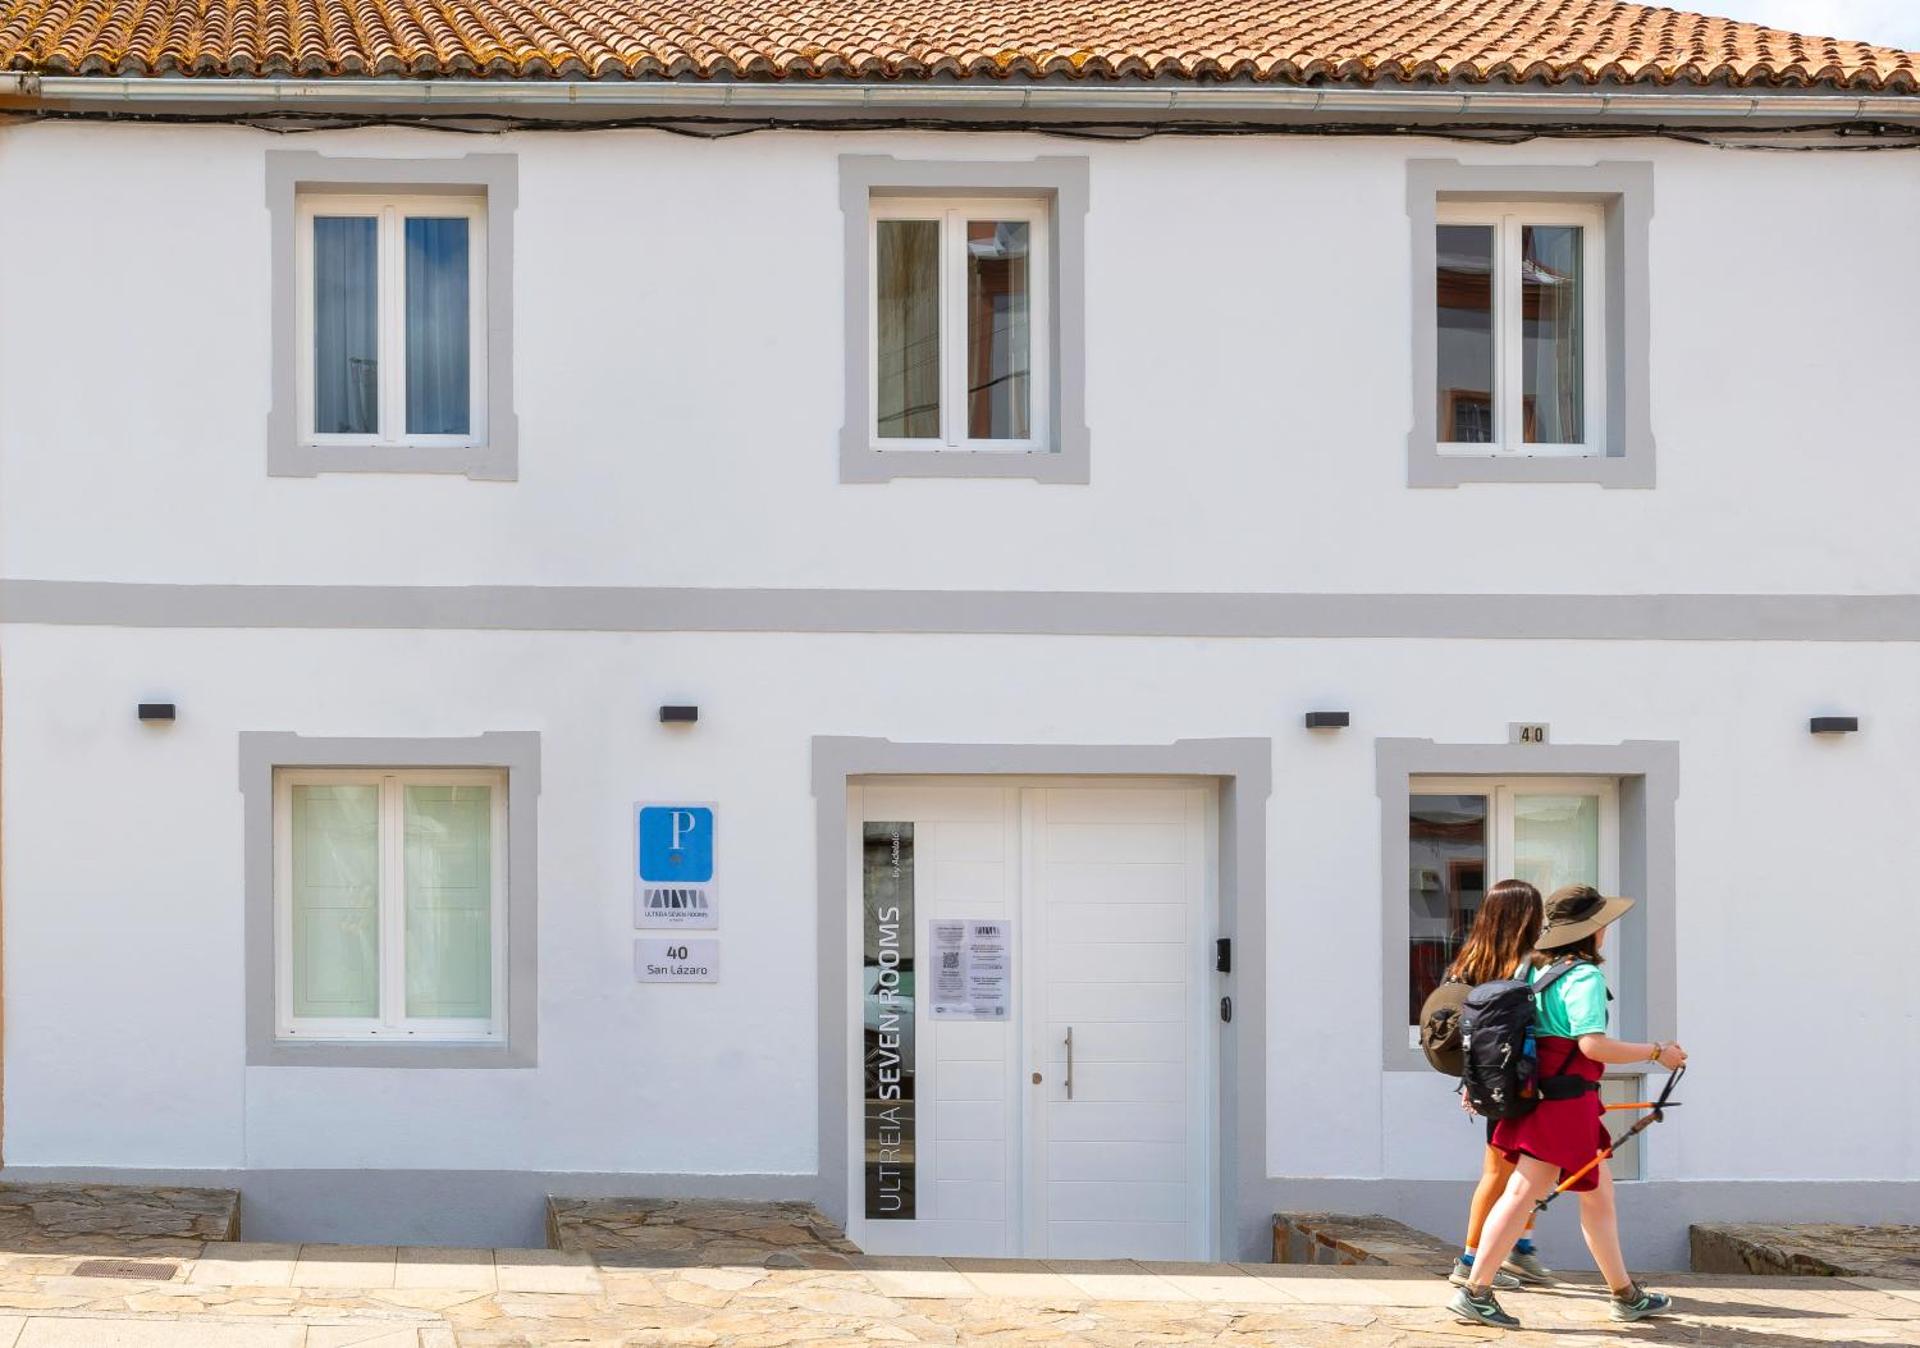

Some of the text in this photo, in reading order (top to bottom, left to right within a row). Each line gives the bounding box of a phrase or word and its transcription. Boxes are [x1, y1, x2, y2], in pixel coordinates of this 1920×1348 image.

[1521, 727, 1543, 742] 40
[668, 811, 696, 850] P
[666, 946, 688, 960] 40
[647, 963, 708, 975] San Lázaro
[879, 906, 901, 1211] ULTREIA SEVEN ROOMS
